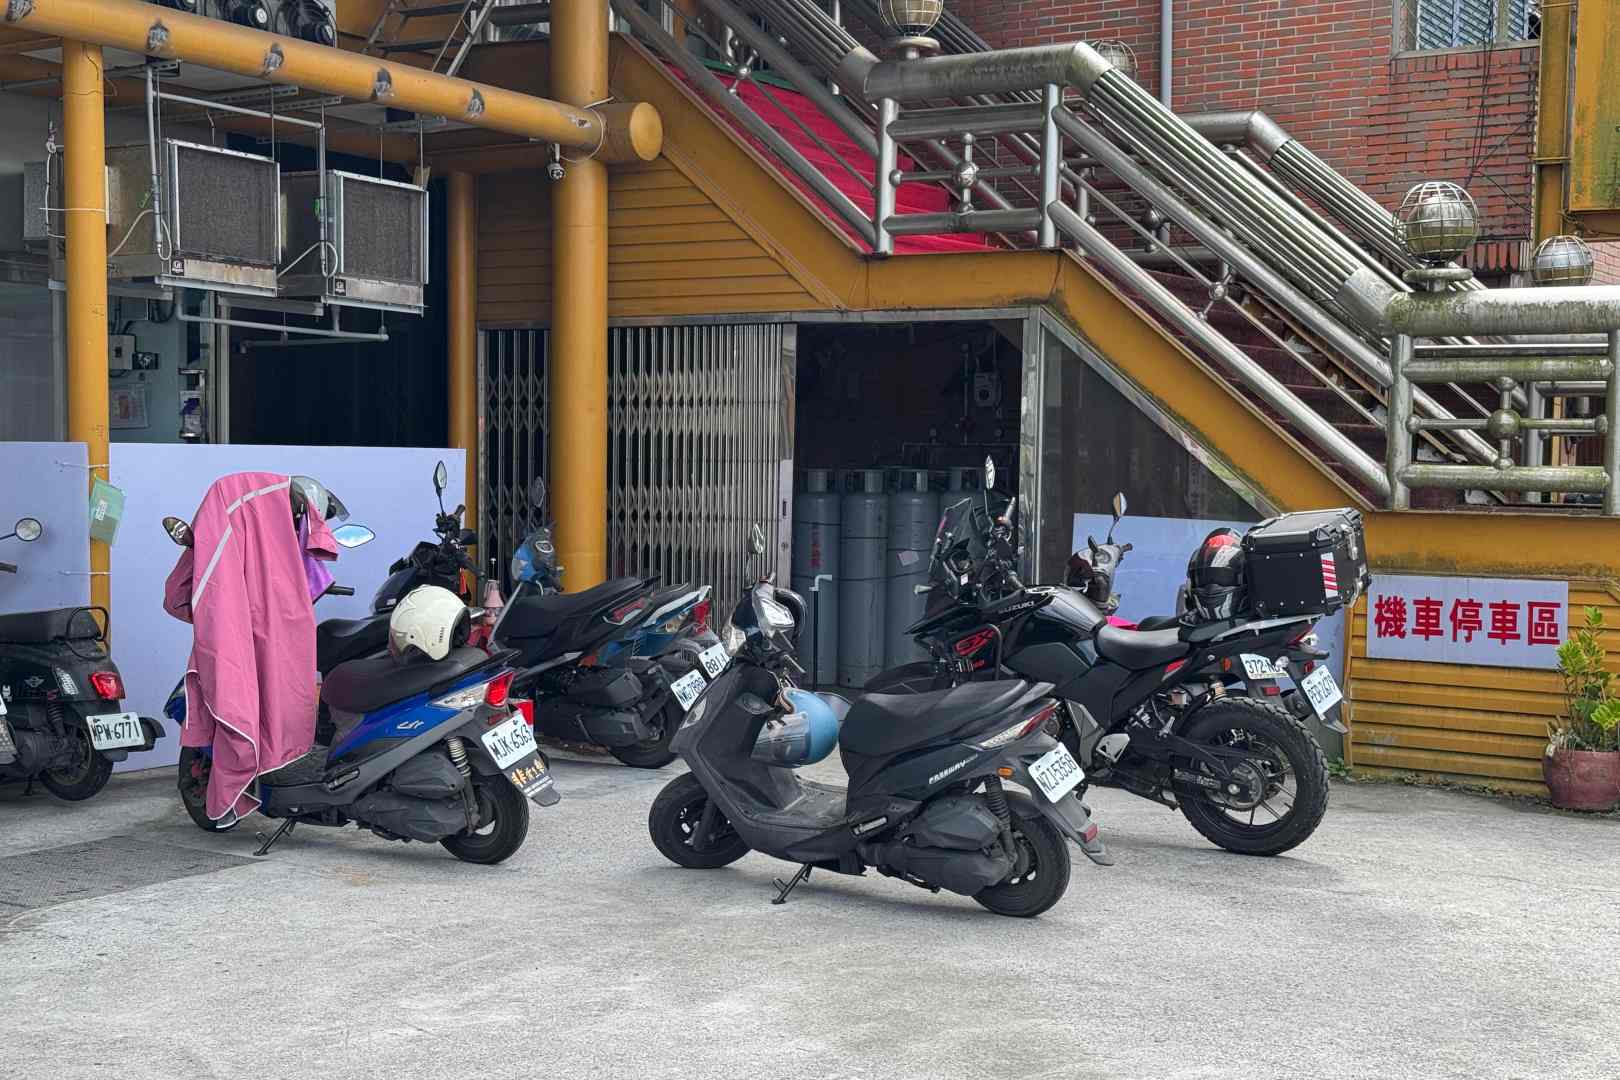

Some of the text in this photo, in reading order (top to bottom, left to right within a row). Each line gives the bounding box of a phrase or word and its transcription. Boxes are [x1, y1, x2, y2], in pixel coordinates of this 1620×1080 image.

[1374, 595, 1561, 646] 機車停車區
